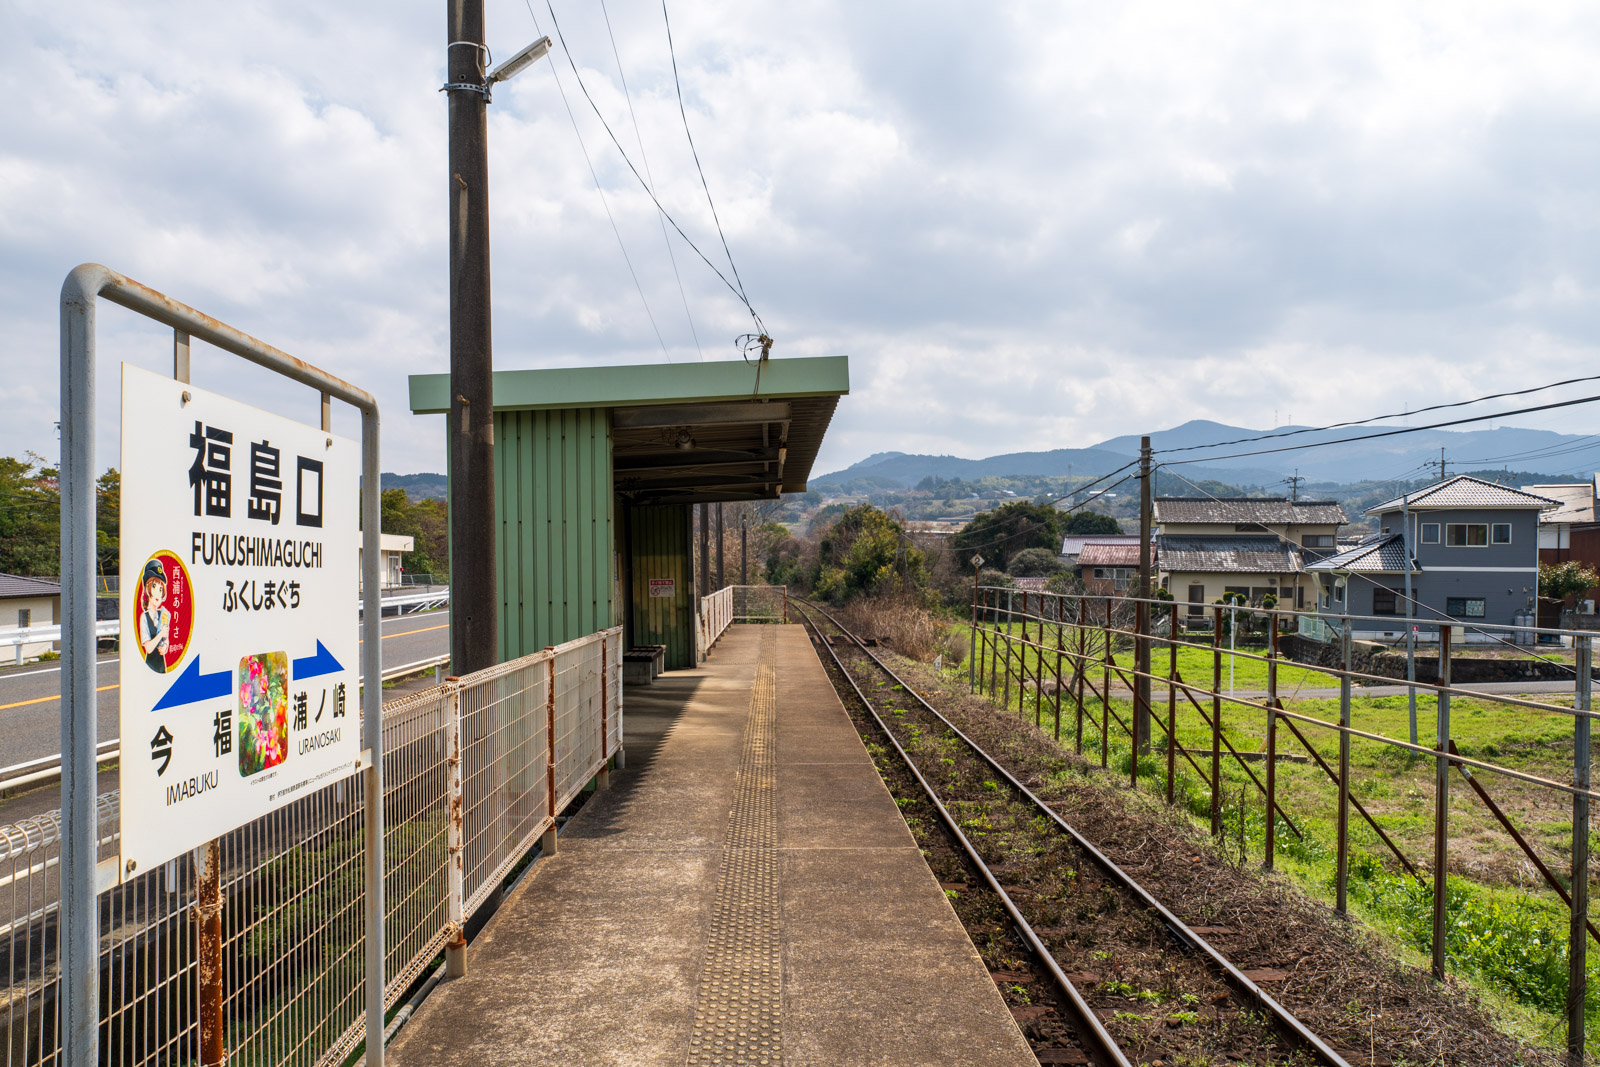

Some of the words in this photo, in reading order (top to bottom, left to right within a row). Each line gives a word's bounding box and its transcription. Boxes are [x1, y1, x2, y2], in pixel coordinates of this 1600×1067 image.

[189, 421, 323, 528] 福島口
[192, 532, 321, 568] FUKUSHIMAGUCHI
[223, 580, 300, 612] ふくしまぐち
[293, 683, 345, 731] 浦ノ崎
[151, 710, 232, 777] 今福
[299, 730, 340, 755] URANOSAKI
[167, 770, 218, 806] IMABUKU
